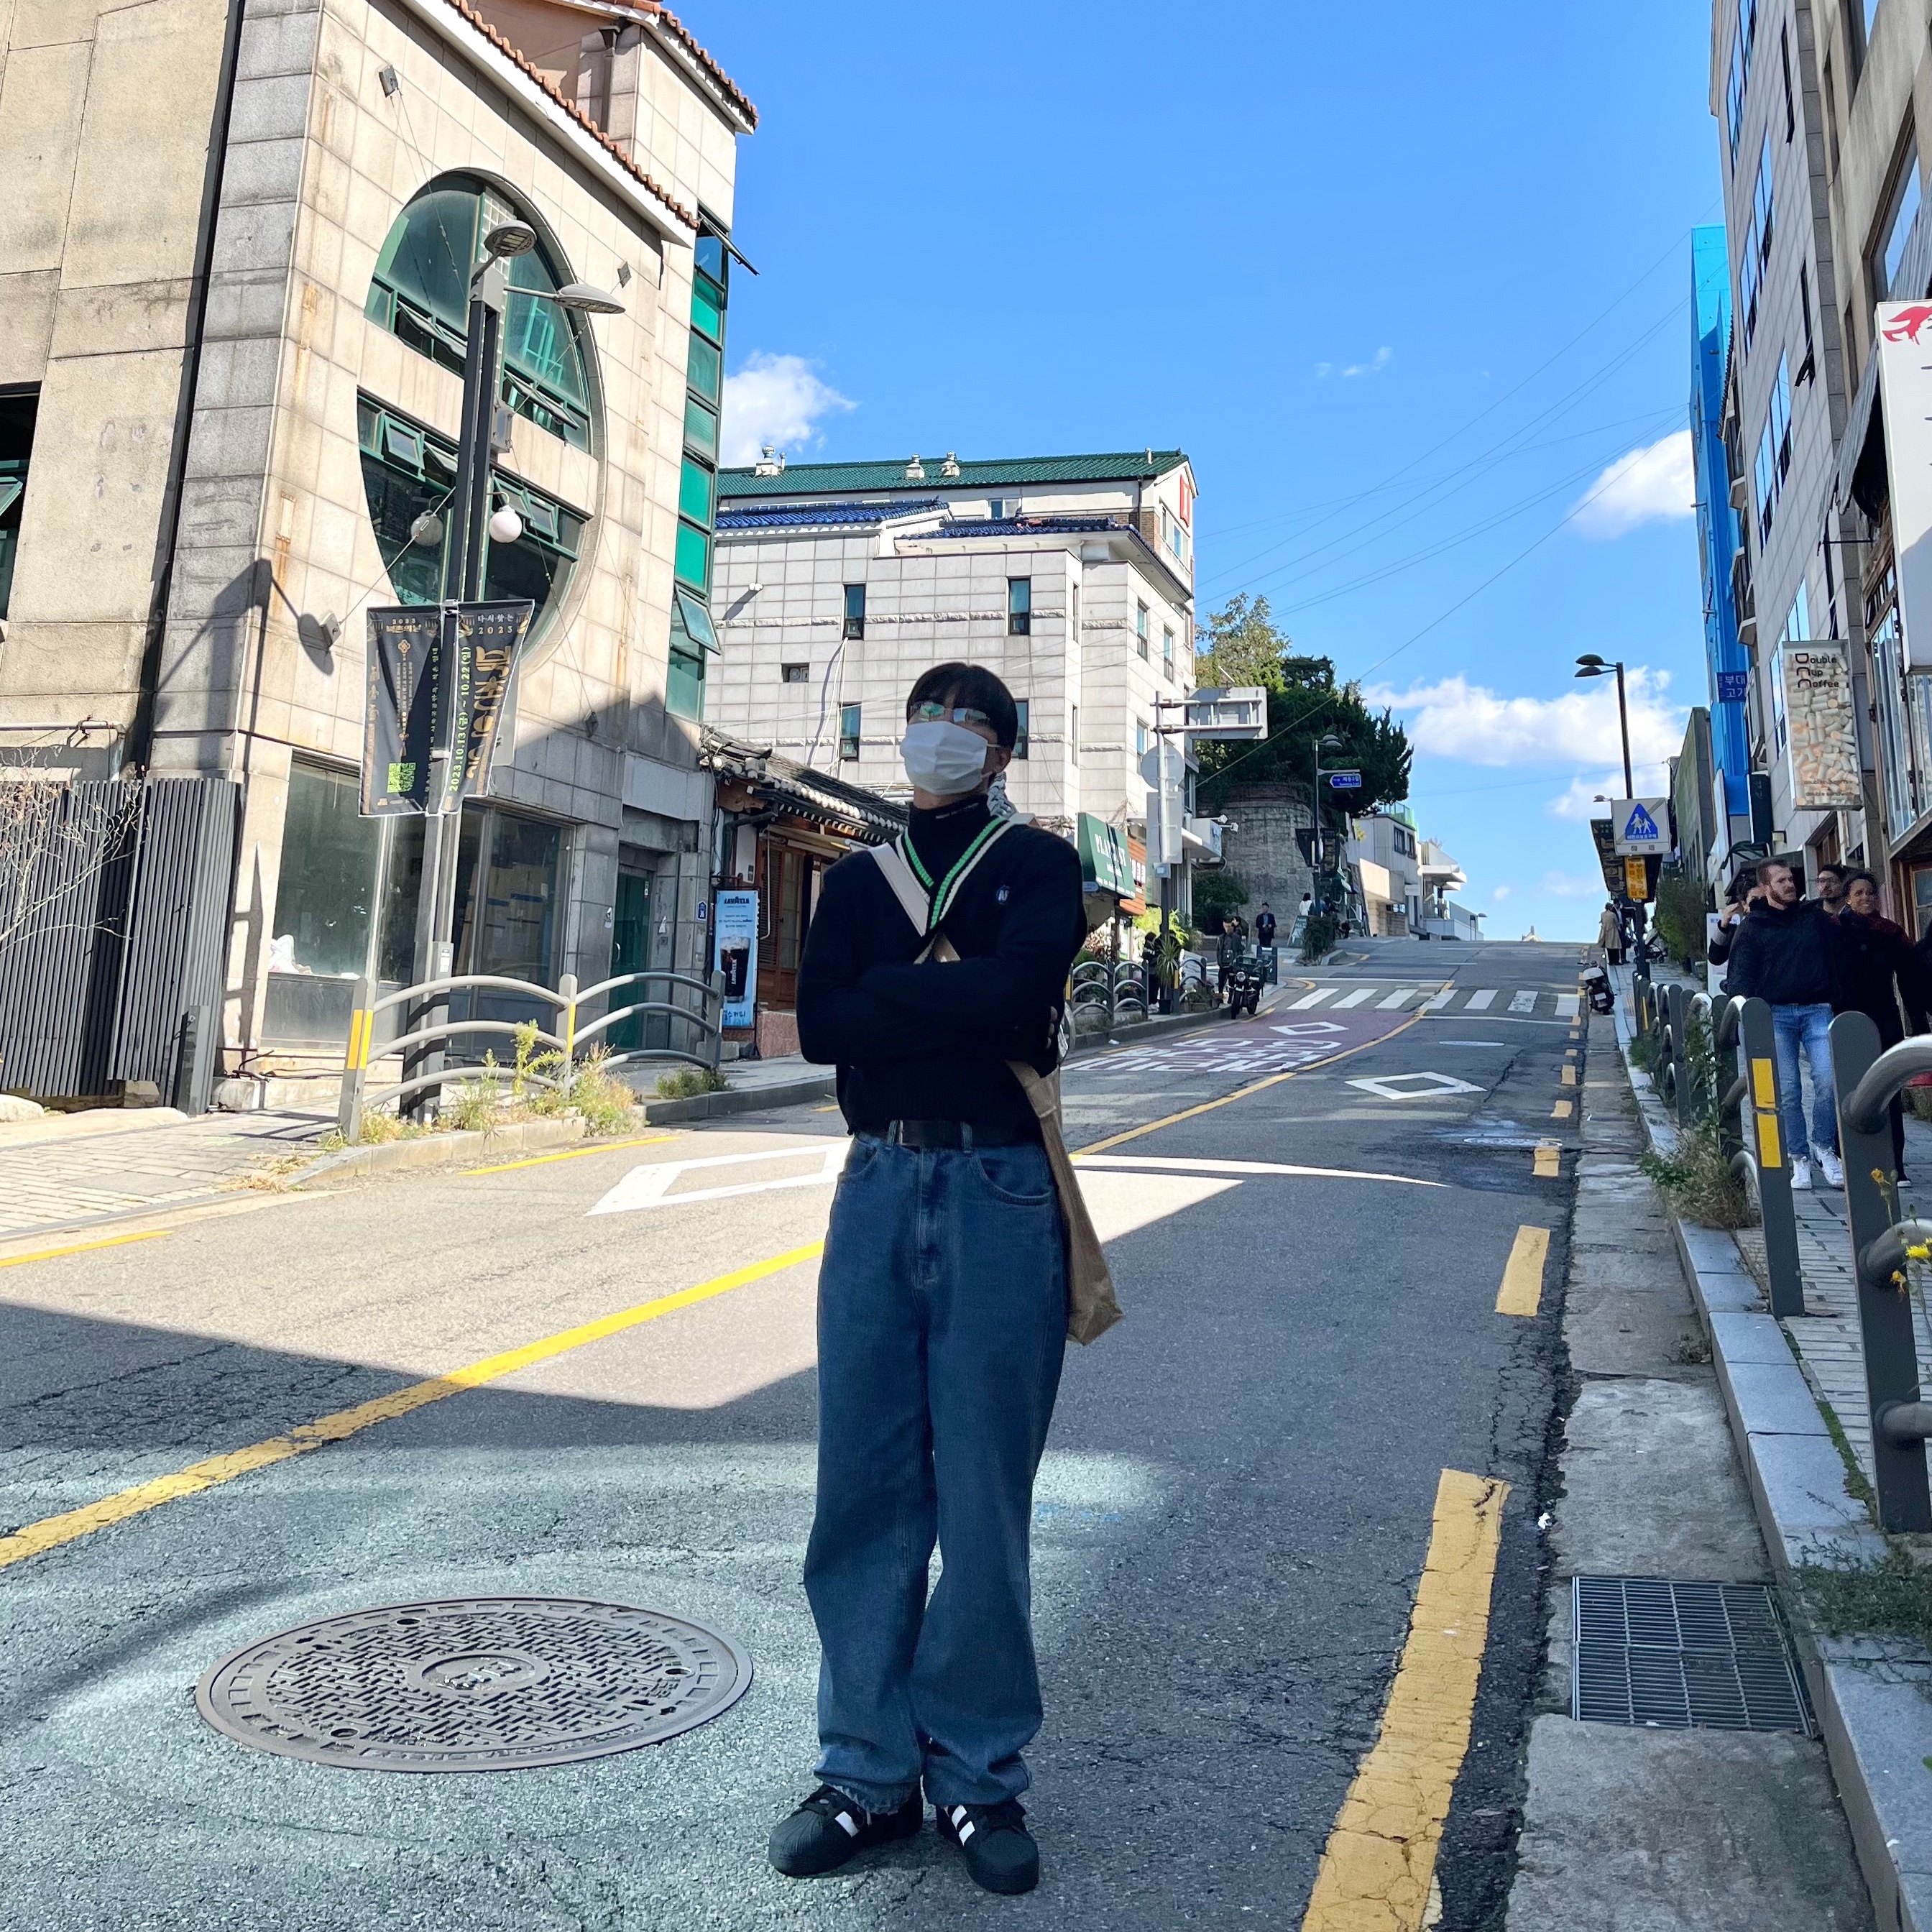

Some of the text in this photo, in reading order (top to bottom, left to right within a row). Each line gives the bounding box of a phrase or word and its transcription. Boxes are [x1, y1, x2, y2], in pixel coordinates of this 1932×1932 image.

[478, 625, 513, 635] 2023
[1795, 653, 1838, 664] Double
[1725, 674, 1746, 685] 부대
